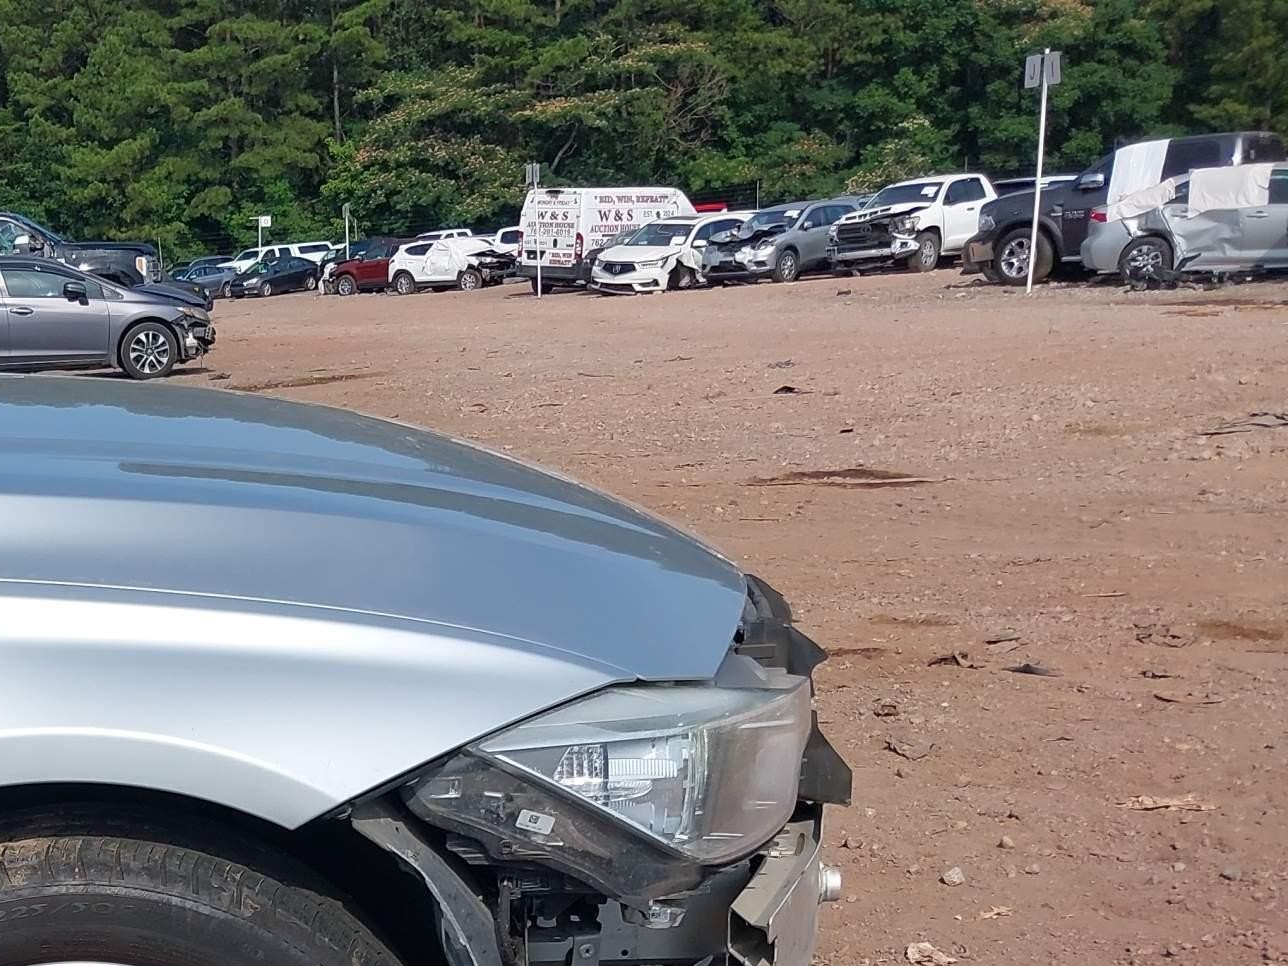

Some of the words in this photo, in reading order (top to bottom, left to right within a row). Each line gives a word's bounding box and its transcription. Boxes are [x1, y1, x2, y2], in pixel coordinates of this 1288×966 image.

[550, 210, 559, 221] &
[562, 211, 569, 221] S
[598, 209, 611, 222] W
[614, 209, 624, 222] &
[627, 209, 633, 222] S
[526, 221, 554, 229] AUTION
[589, 223, 619, 234] AUCTION
